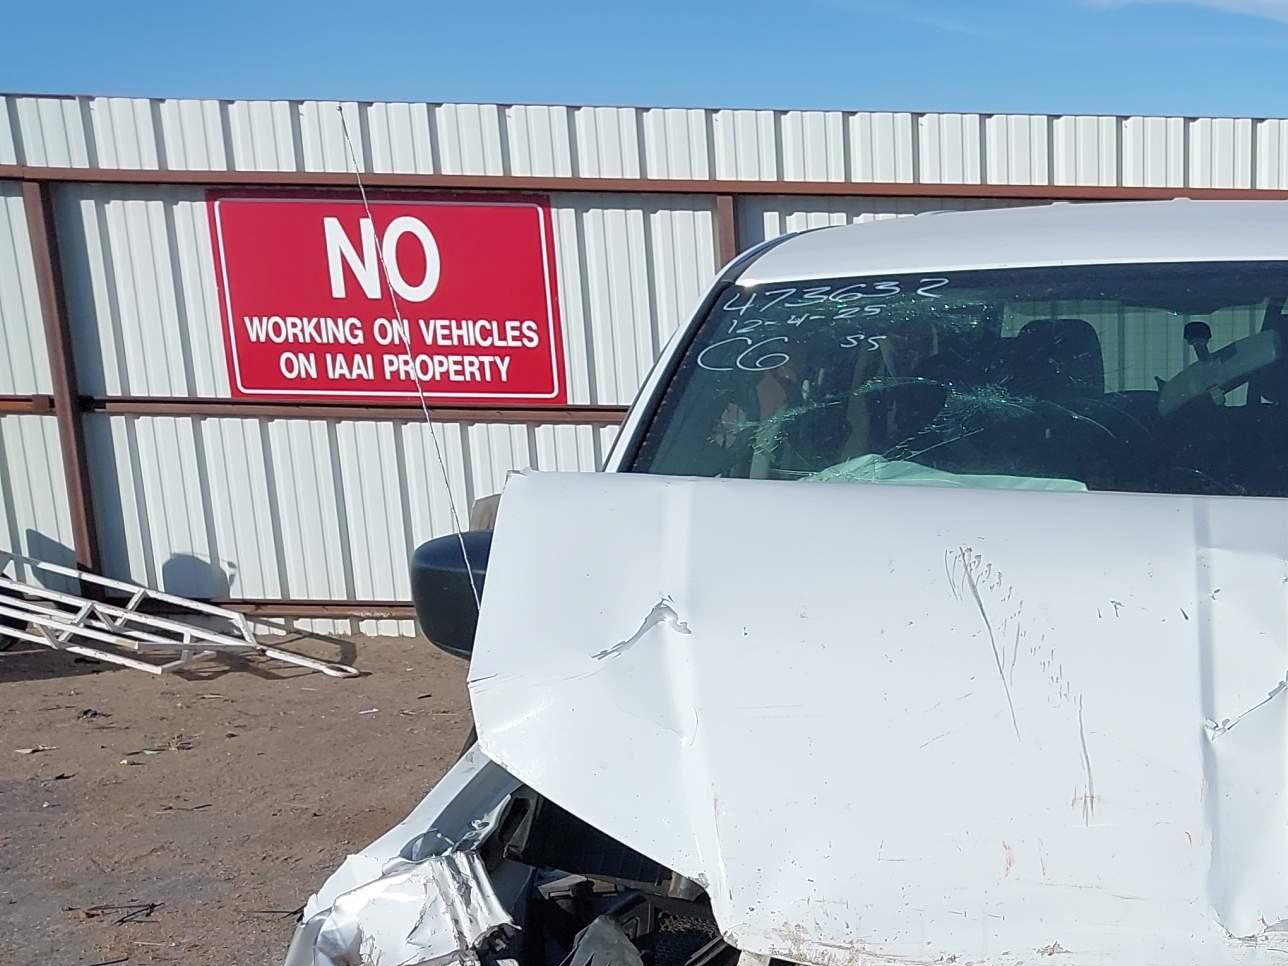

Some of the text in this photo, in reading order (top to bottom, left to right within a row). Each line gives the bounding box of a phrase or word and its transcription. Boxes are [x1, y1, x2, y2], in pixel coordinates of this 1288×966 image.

[322, 215, 442, 303] NO
[243, 315, 540, 348] WORKING ON VEHICLES
[279, 352, 511, 383] ON IAAI PROPERTY
